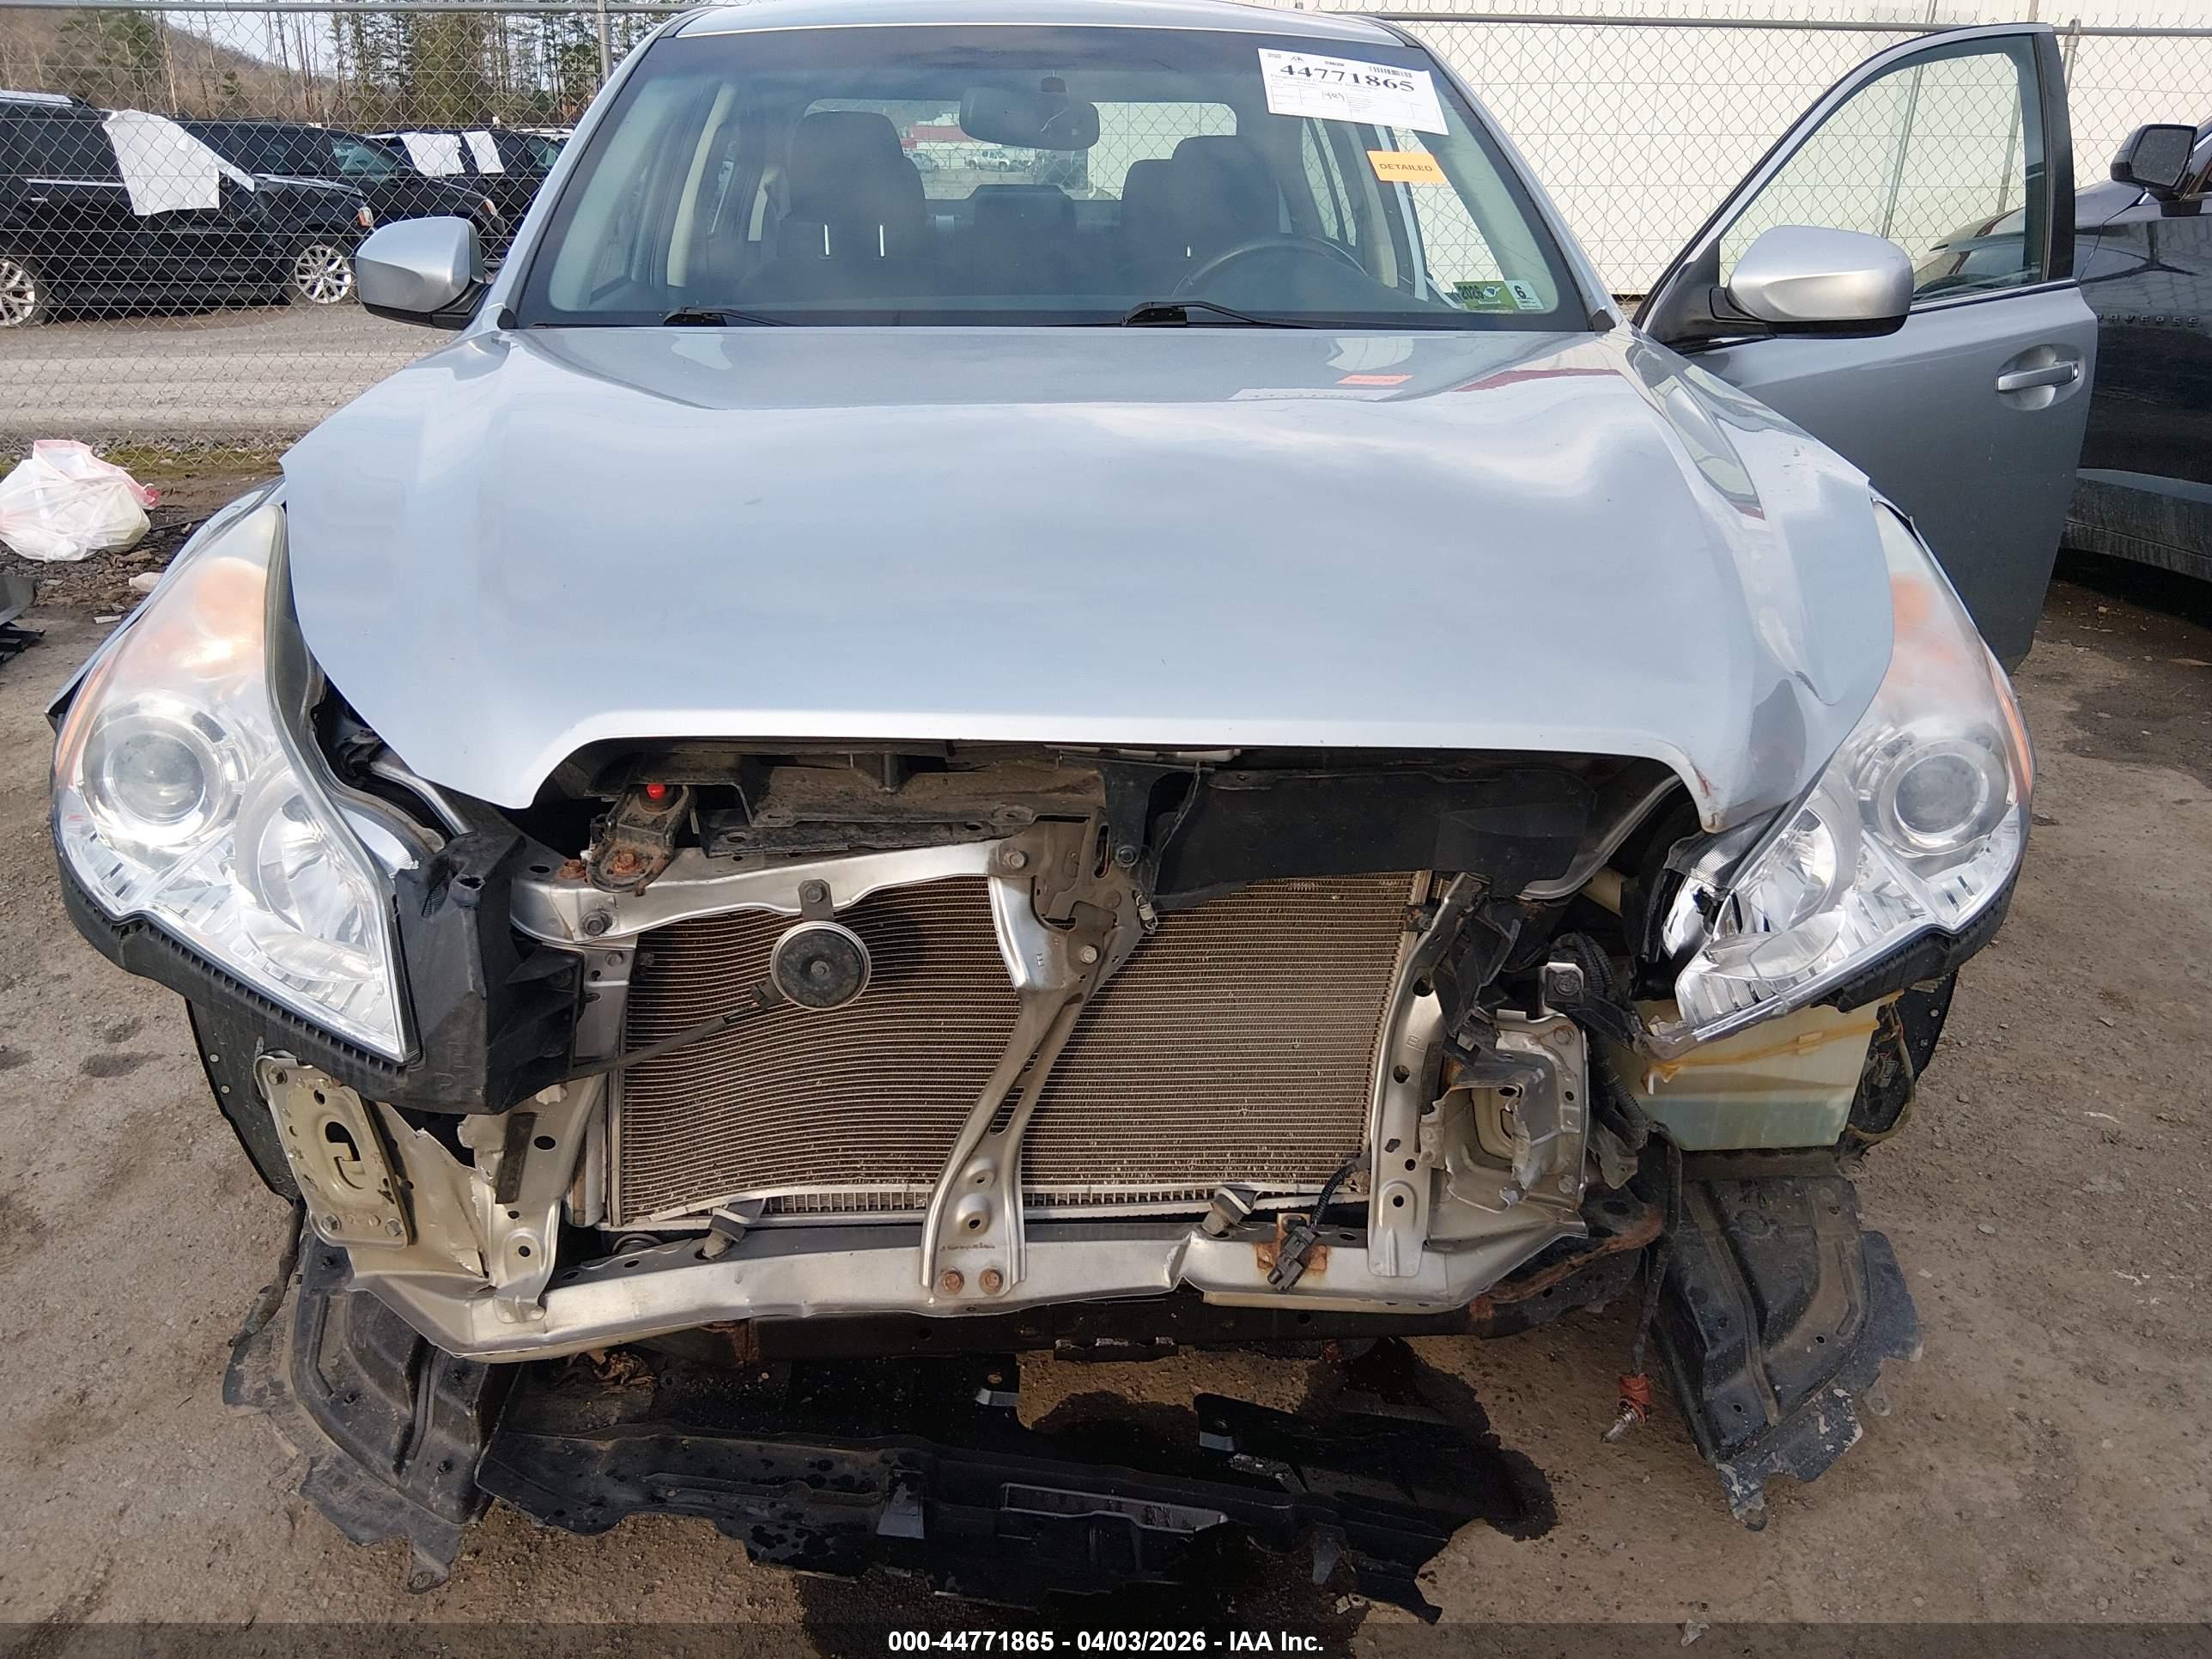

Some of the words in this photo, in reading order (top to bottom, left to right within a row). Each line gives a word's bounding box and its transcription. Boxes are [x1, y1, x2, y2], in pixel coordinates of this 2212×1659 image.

[1280, 64, 1415, 92] 44771865
[1378, 163, 1433, 172] DETAILED
[1457, 285, 1485, 301] 2026
[1514, 285, 1527, 300] 6
[2097, 314, 2199, 328] RAVERSE
